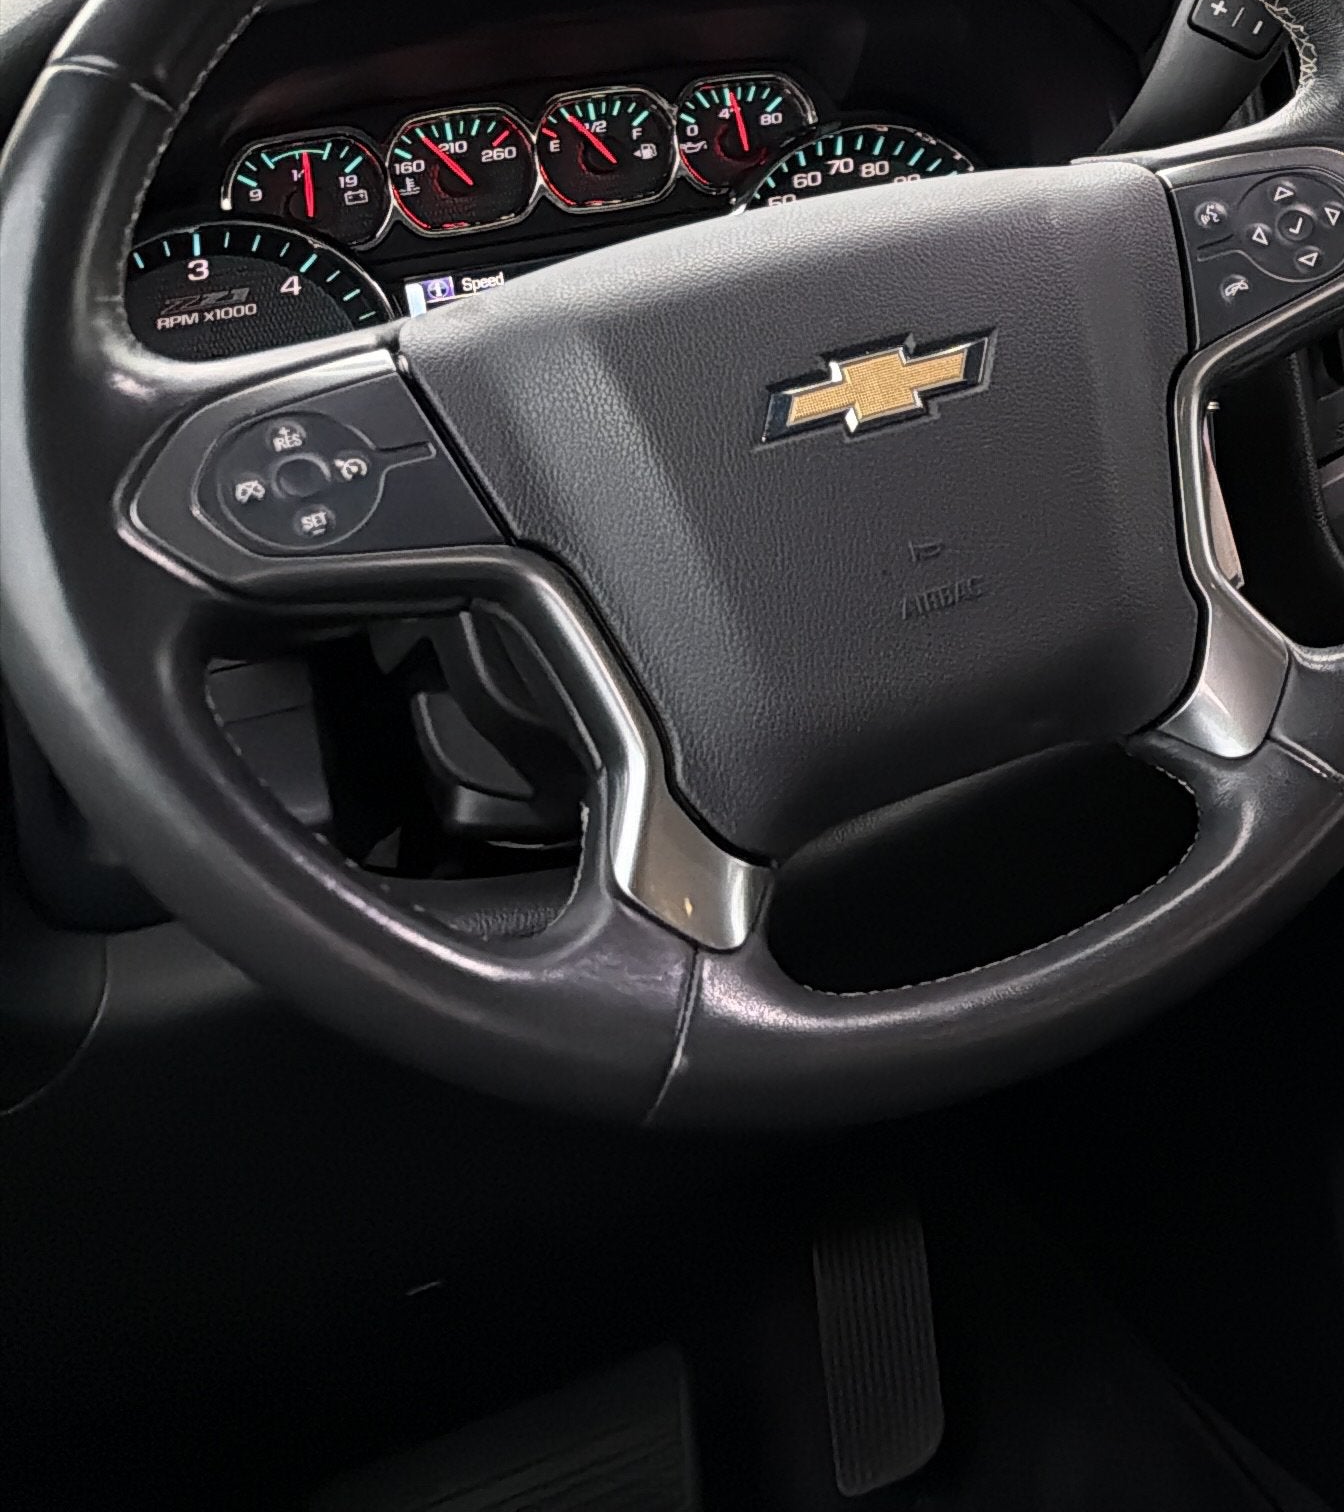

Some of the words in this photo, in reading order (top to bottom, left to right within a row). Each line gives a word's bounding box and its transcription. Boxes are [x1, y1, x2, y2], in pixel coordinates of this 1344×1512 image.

[760, 112, 783, 127] 80
[631, 126, 643, 140] F
[686, 124, 698, 137] 0
[438, 140, 468, 155] 210
[549, 138, 561, 153] E
[481, 146, 518, 164] 260
[394, 159, 425, 176] 160
[825, 157, 855, 176] 70
[860, 160, 889, 178] 80
[339, 174, 359, 188] 19
[792, 171, 822, 189] 60
[248, 188, 263, 202] 9
[187, 258, 210, 281] 3
[280, 274, 303, 296] 4
[461, 271, 505, 294] Speed
[160, 287, 250, 317] Z71
[156, 312, 200, 331] RPM
[272, 433, 303, 453] RES
[301, 511, 328, 532] SET
